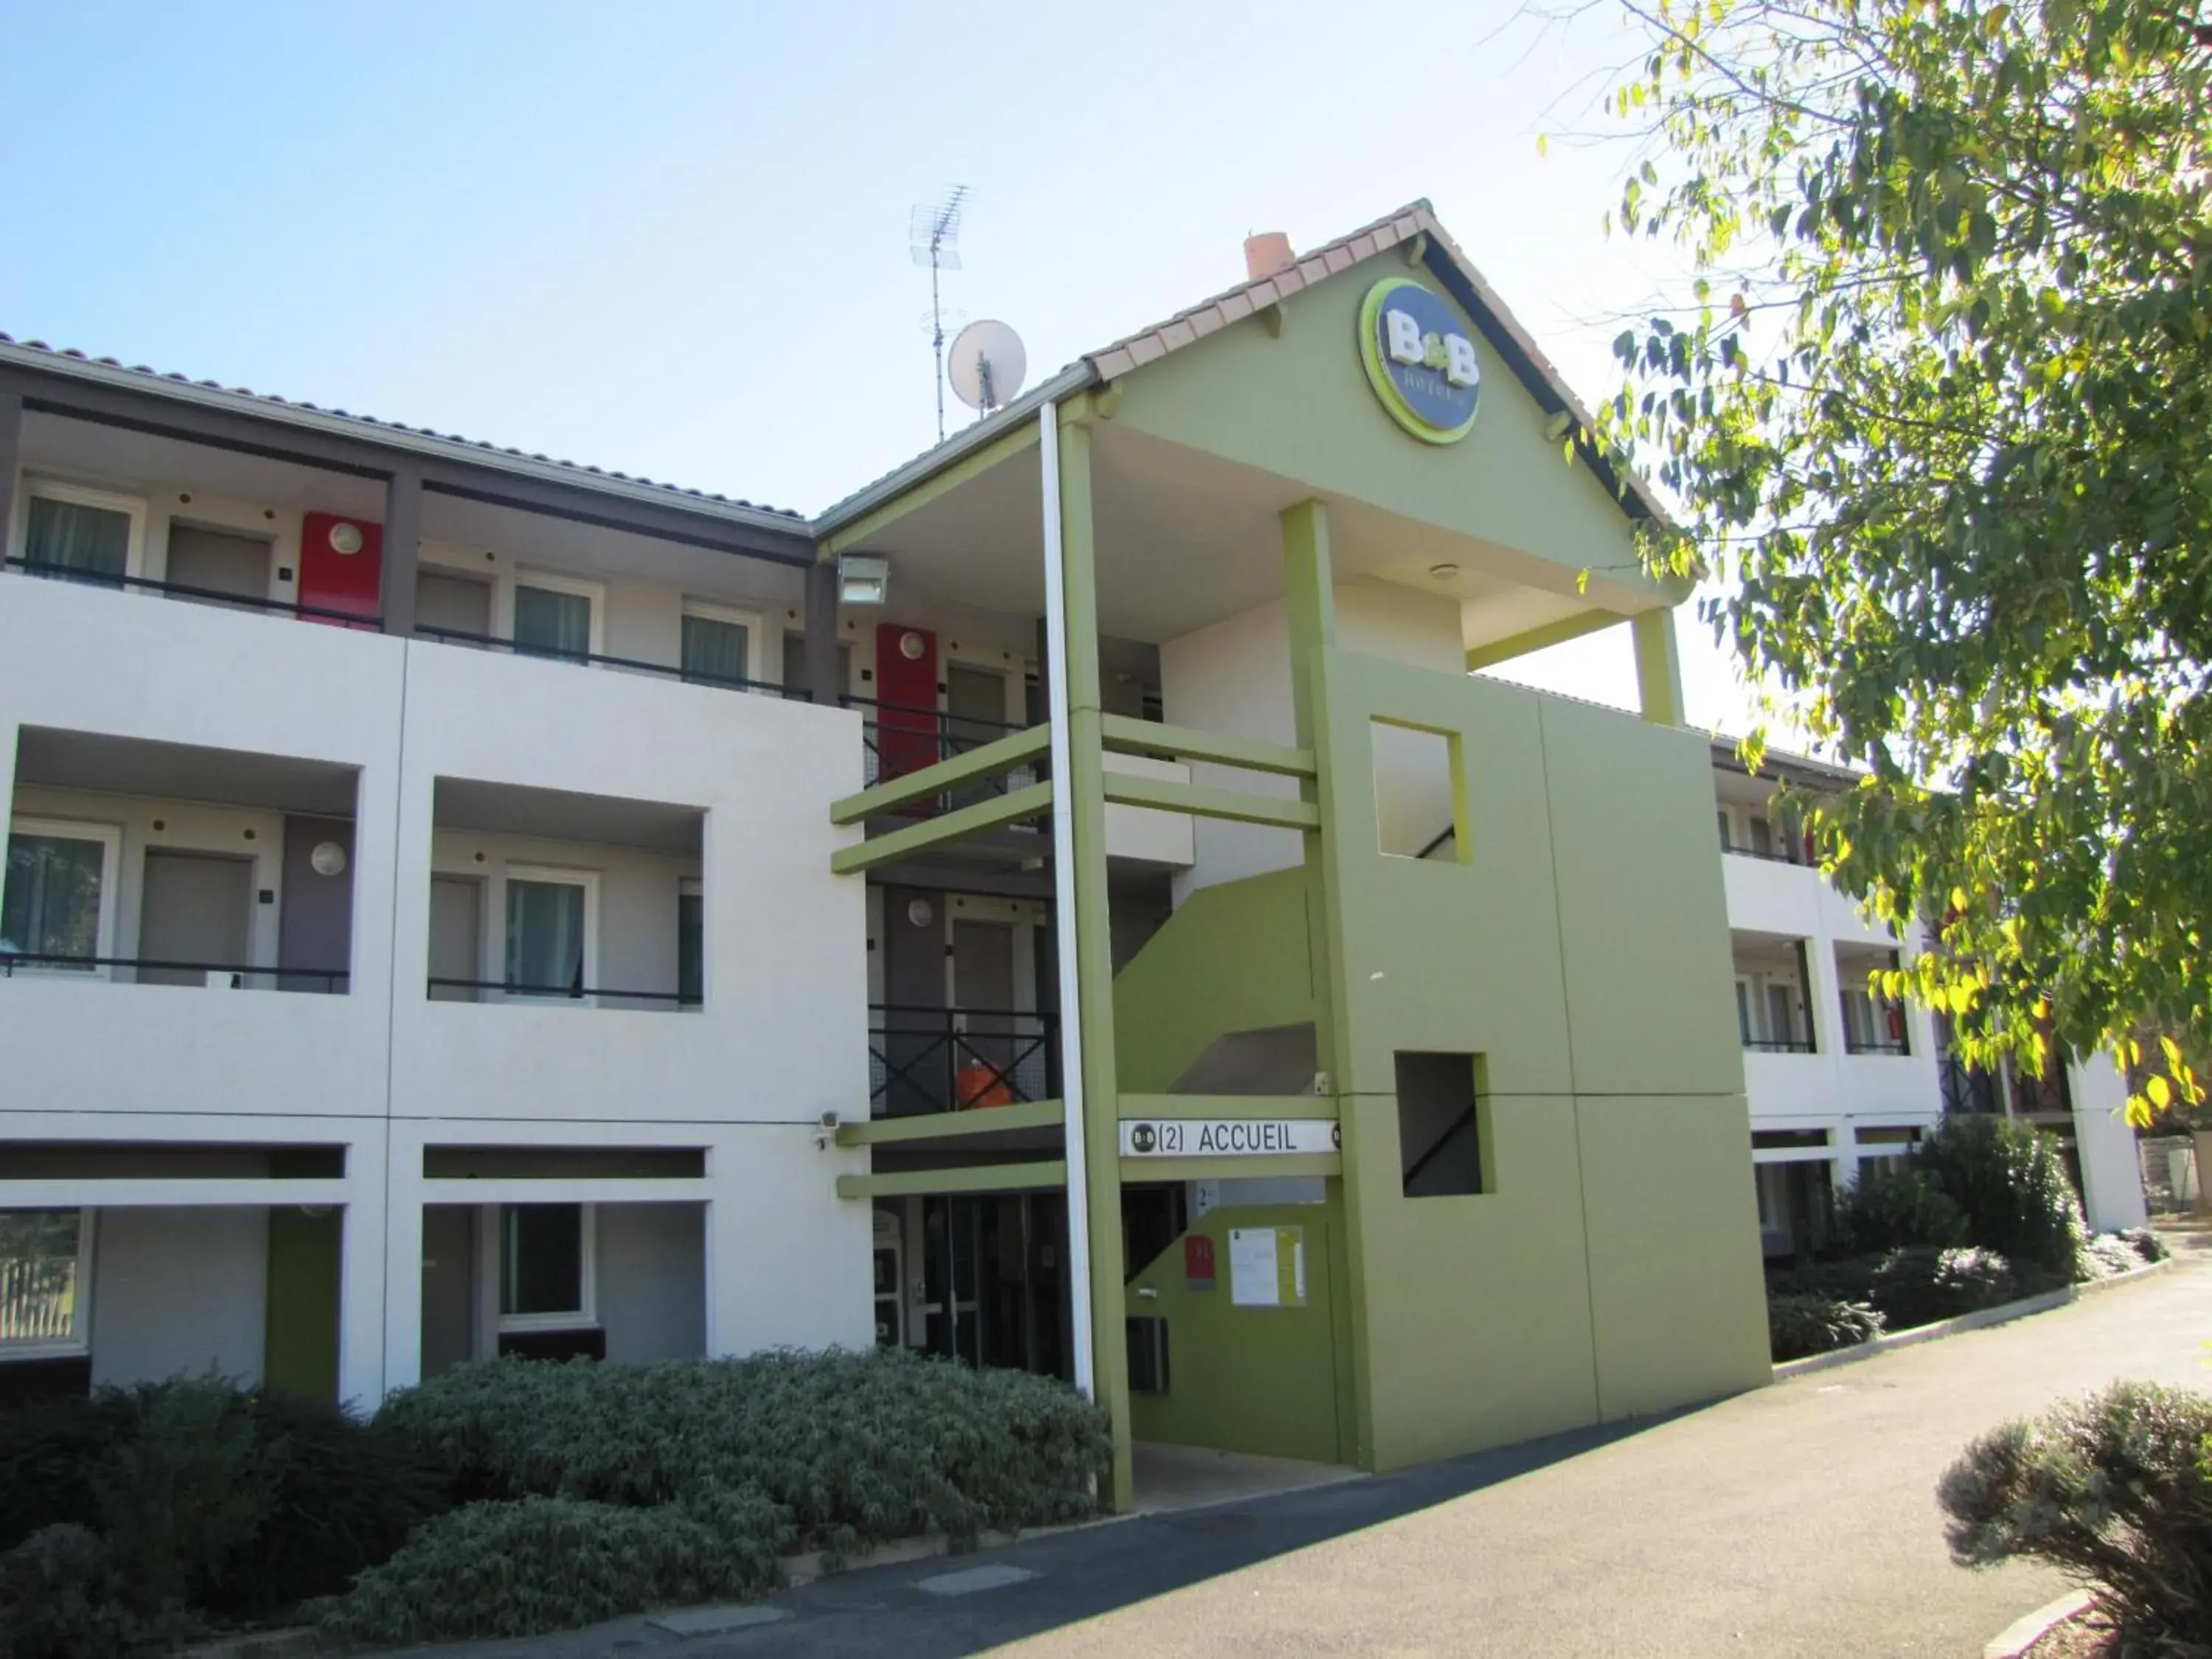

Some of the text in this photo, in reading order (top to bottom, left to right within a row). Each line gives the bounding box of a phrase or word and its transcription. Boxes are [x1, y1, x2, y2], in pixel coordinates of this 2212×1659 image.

[1387, 309, 1480, 387] B&B
[1159, 1124, 1183, 1152] (2)
[1200, 1124, 1297, 1151] ACCUEIL
